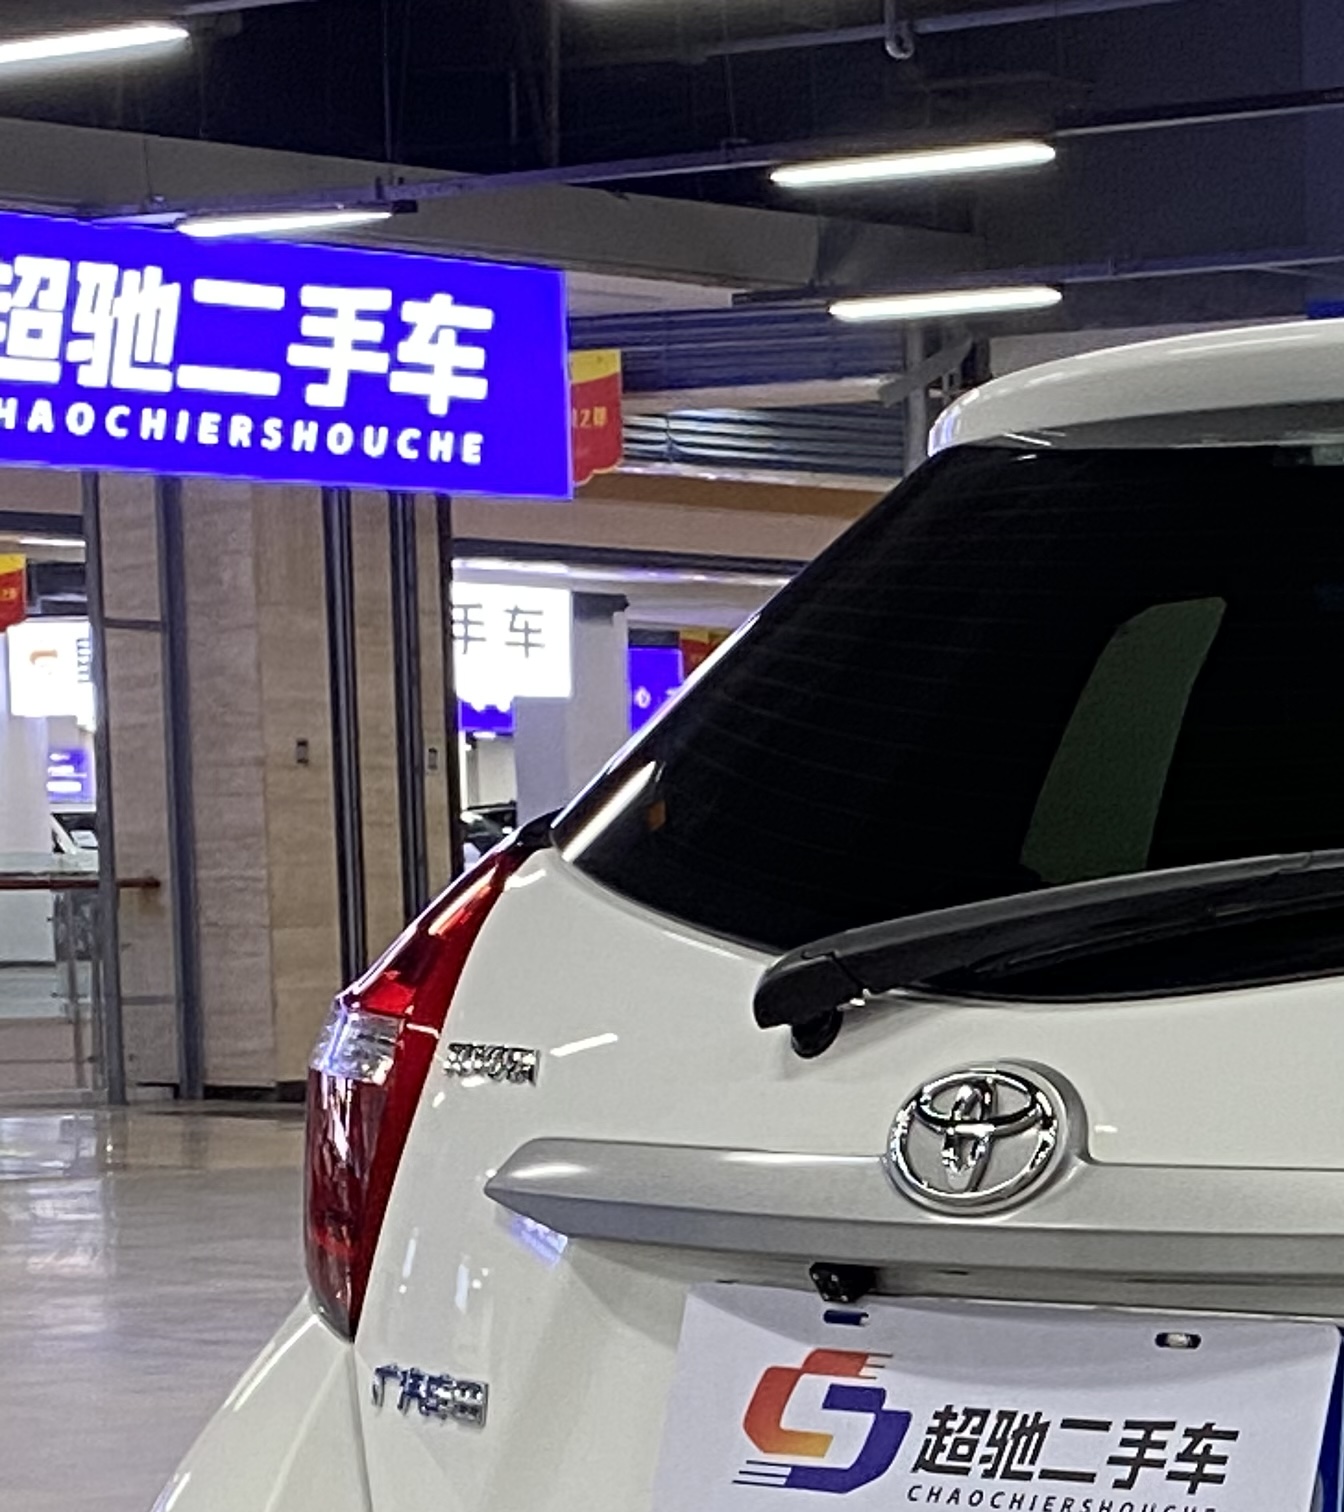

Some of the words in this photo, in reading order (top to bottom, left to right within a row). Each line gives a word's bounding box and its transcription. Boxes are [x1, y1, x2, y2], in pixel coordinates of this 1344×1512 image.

[0, 256, 494, 416] 超驰二手车
[911, 1405, 1239, 1494] 超驰二手车
